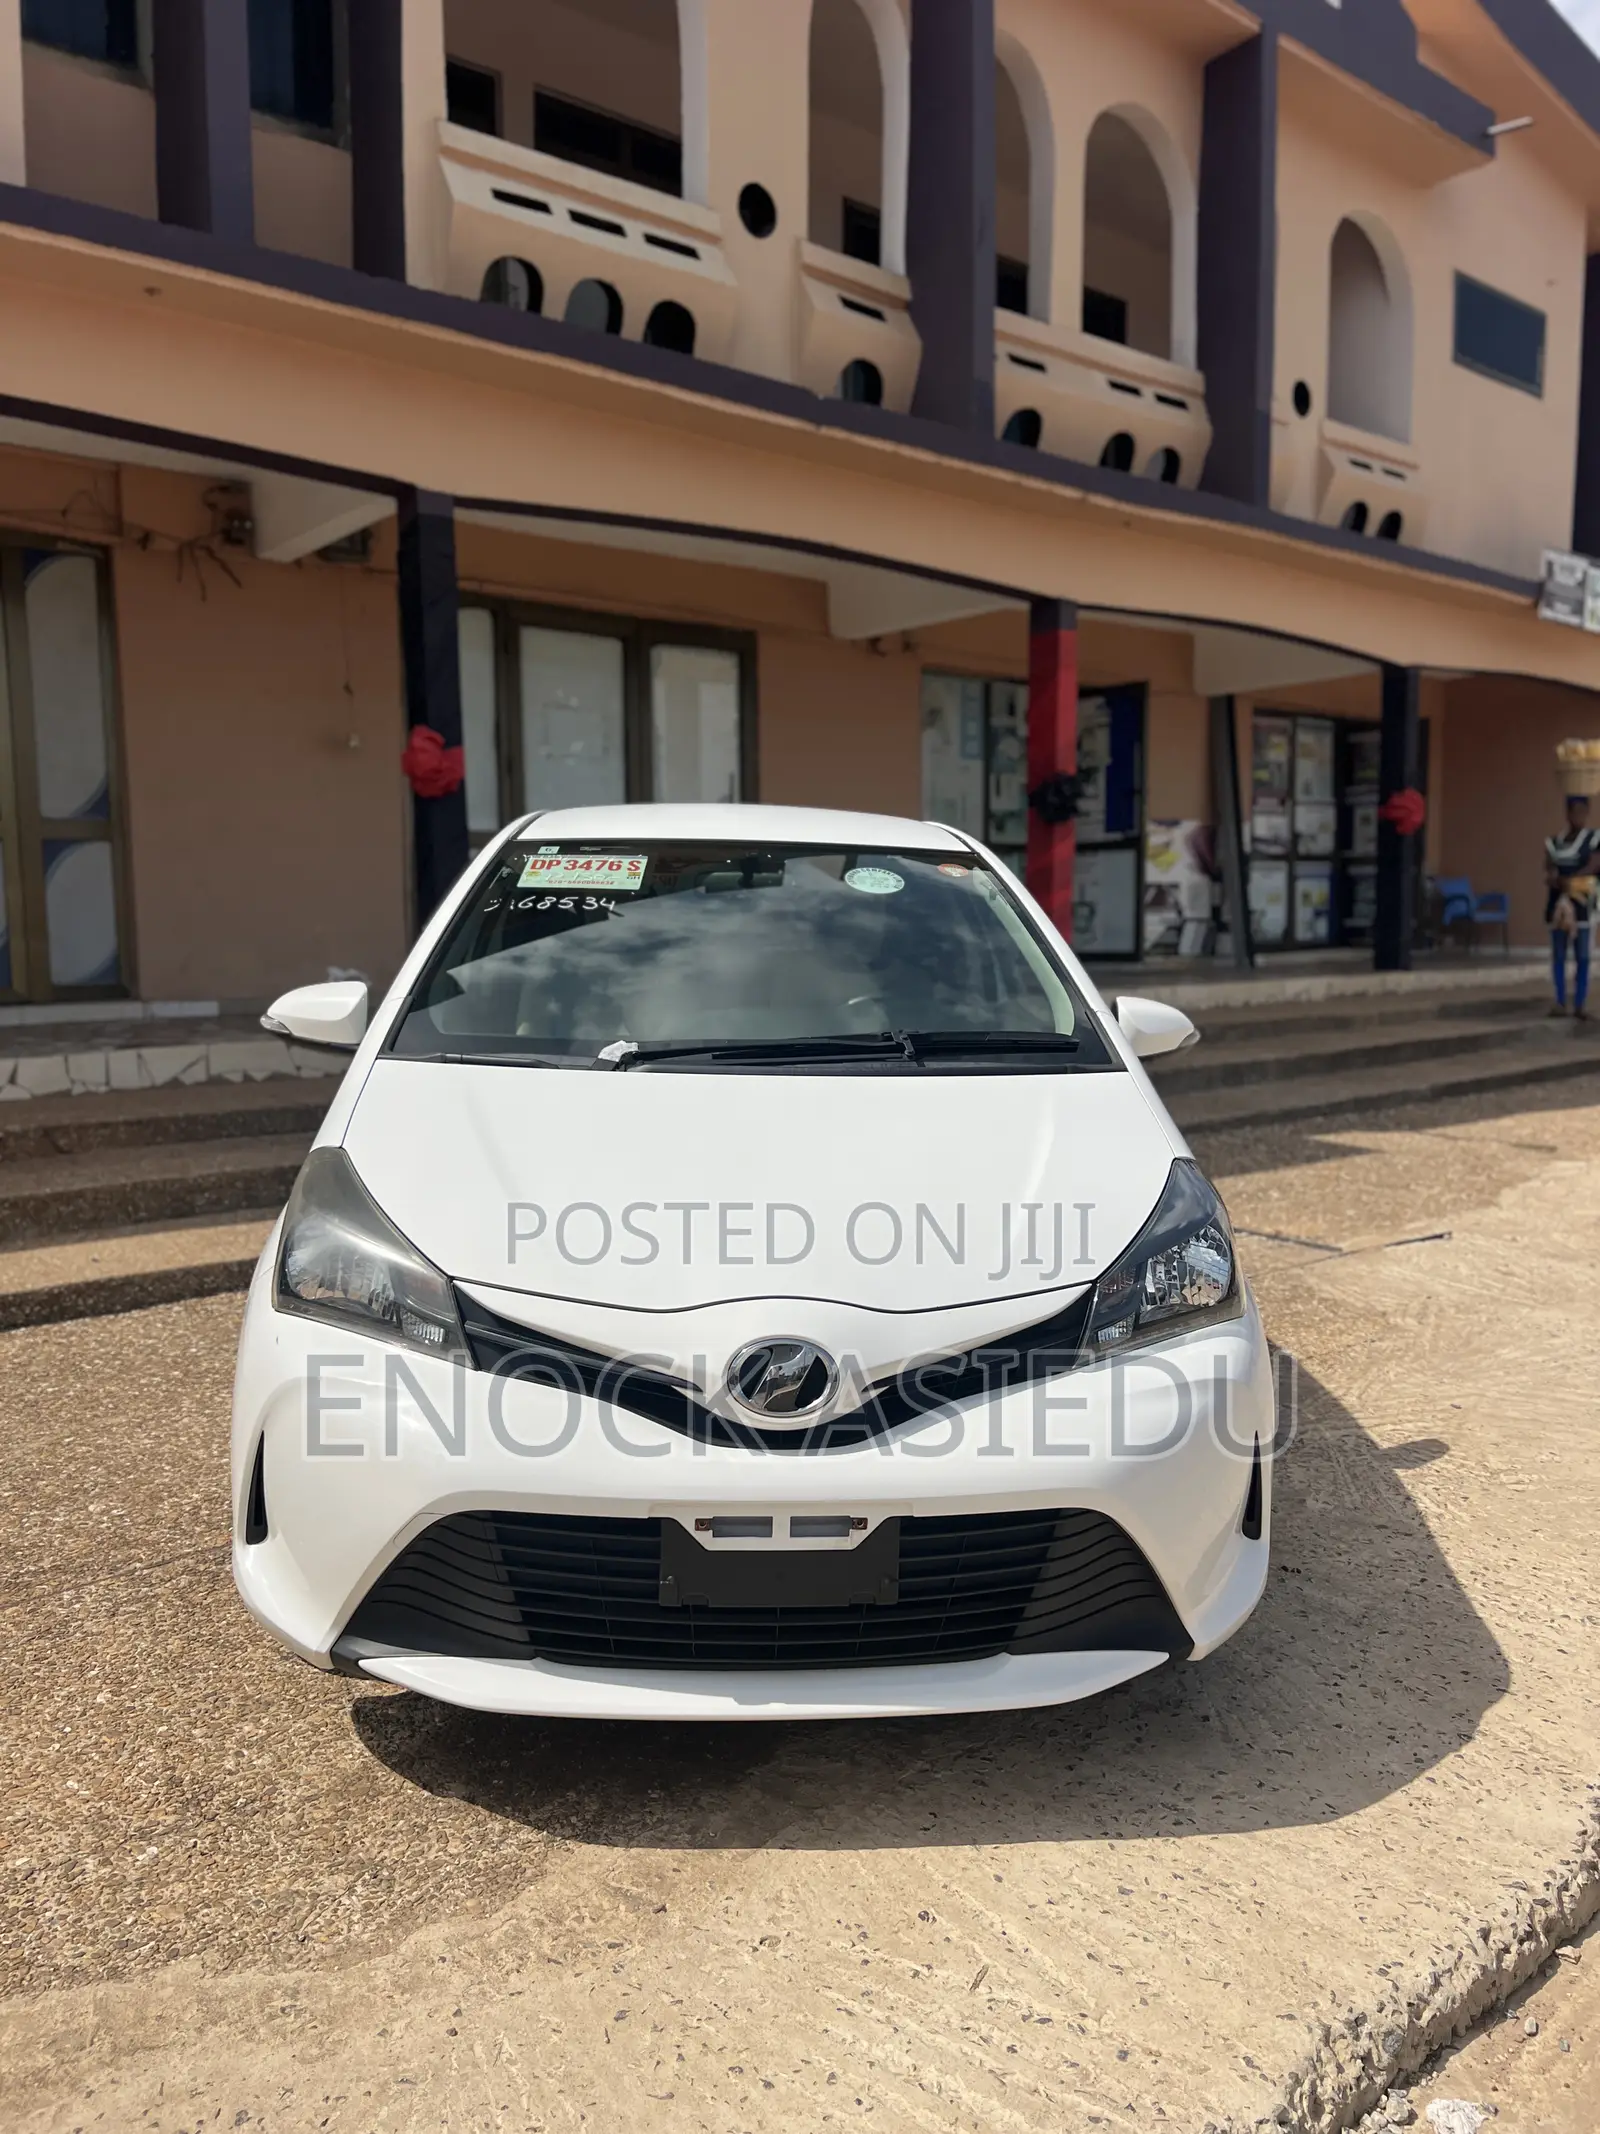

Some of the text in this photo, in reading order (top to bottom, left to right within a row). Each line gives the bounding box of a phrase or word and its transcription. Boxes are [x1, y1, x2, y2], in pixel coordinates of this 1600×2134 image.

[530, 859, 642, 871] DP 3476 S
